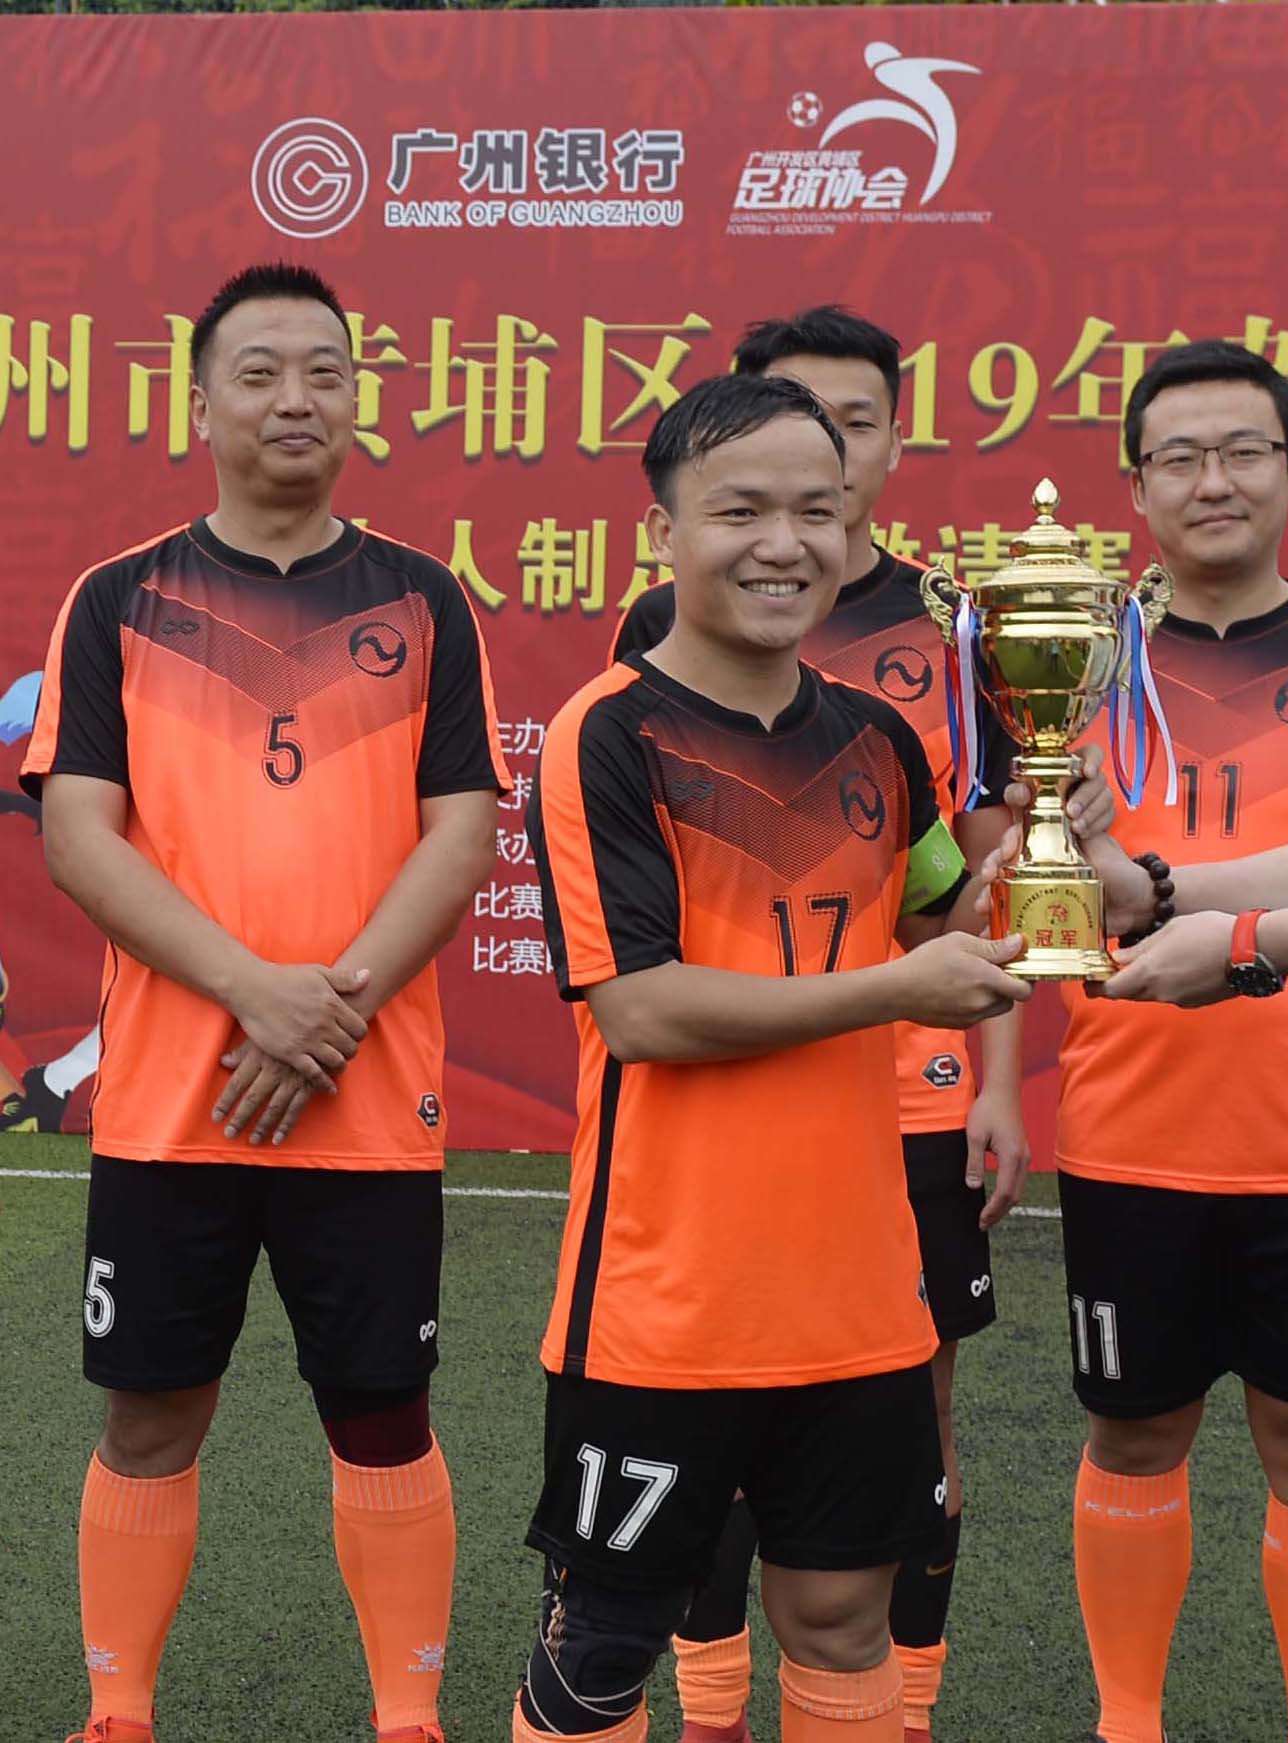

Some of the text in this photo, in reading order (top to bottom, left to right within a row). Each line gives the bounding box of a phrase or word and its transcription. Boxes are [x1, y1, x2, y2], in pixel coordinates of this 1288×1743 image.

[387, 128, 684, 193] 广州银行
[733, 166, 908, 209] 足球协会
[384, 201, 683, 227] BANK OF GUANGZHOU
[262, 711, 305, 790] 5
[1176, 760, 1242, 840] 11
[473, 936, 554, 976] 比赛
[770, 891, 853, 977] 17
[1035, 928, 1078, 947] 冠军
[83, 1256, 115, 1338] 5
[1072, 1295, 1121, 1380] 11
[576, 1442, 678, 1552] 17
